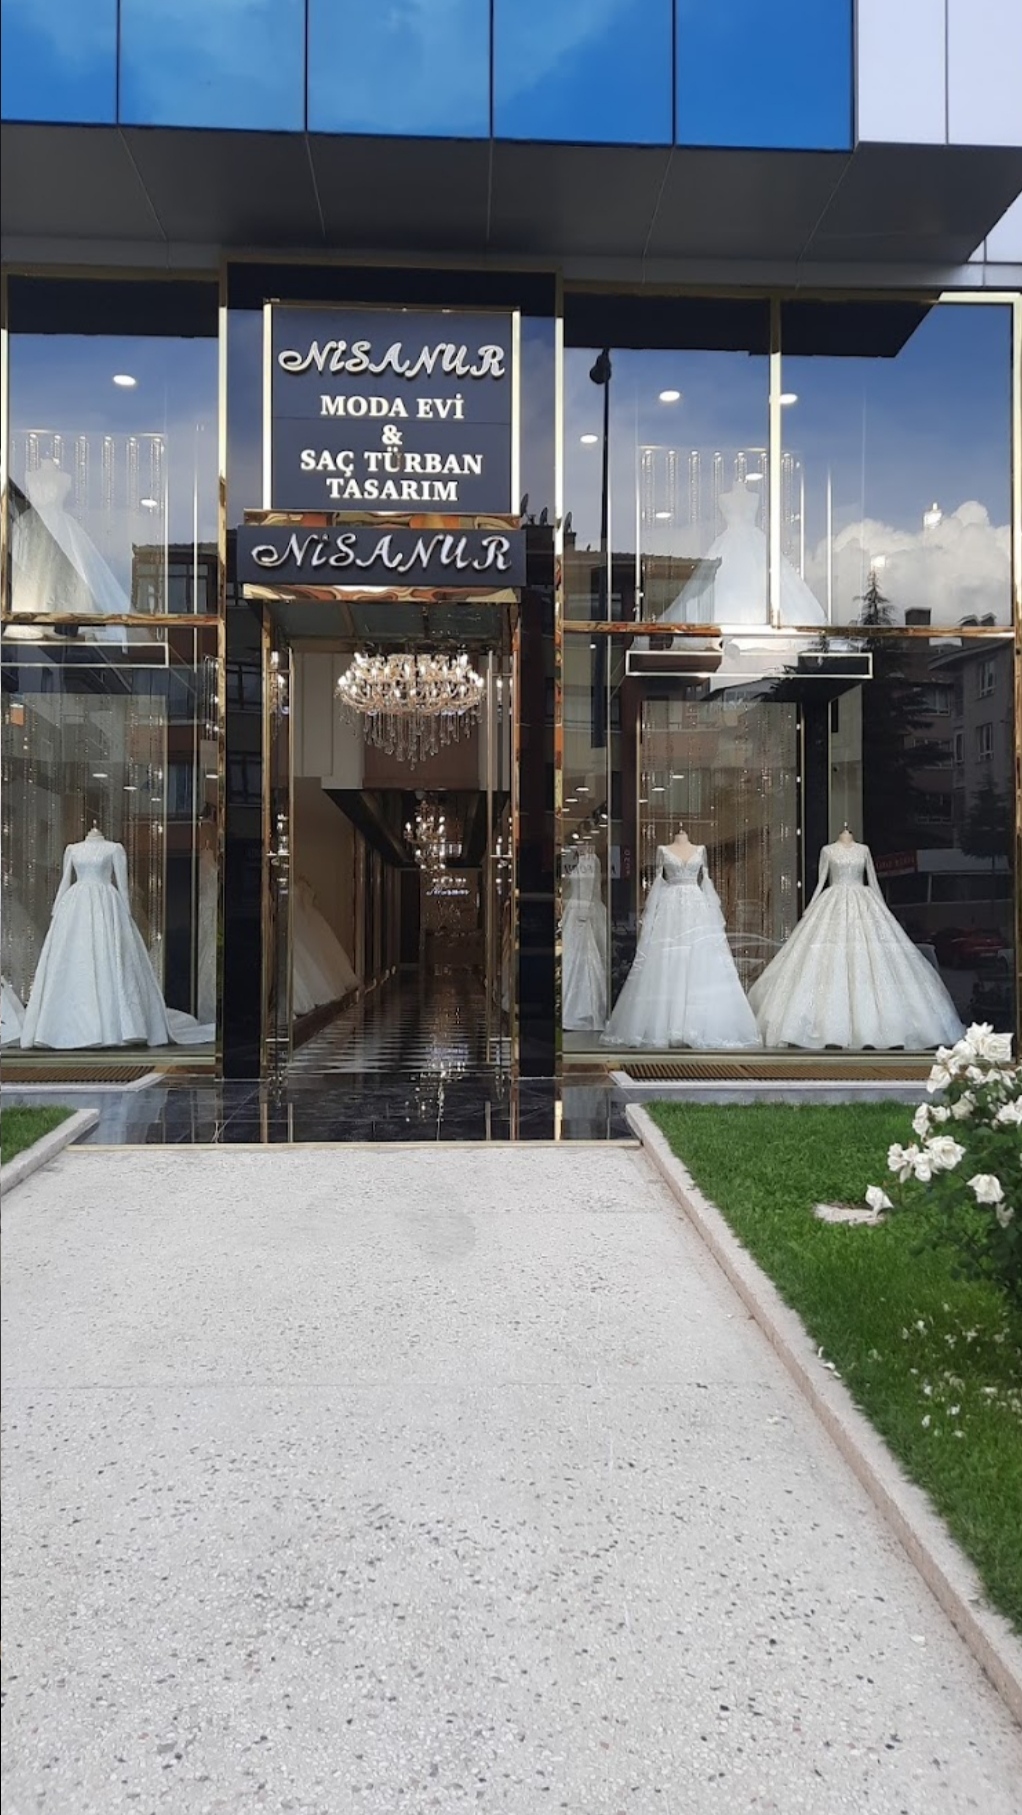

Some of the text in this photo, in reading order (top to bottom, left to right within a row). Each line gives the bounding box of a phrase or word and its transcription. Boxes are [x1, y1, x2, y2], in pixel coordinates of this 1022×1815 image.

[320, 393, 464, 419] MODA EVİ
[382, 424, 403, 445] &
[300, 447, 483, 477] SAÇ TÜRBAN
[326, 478, 458, 501] TASARIM
